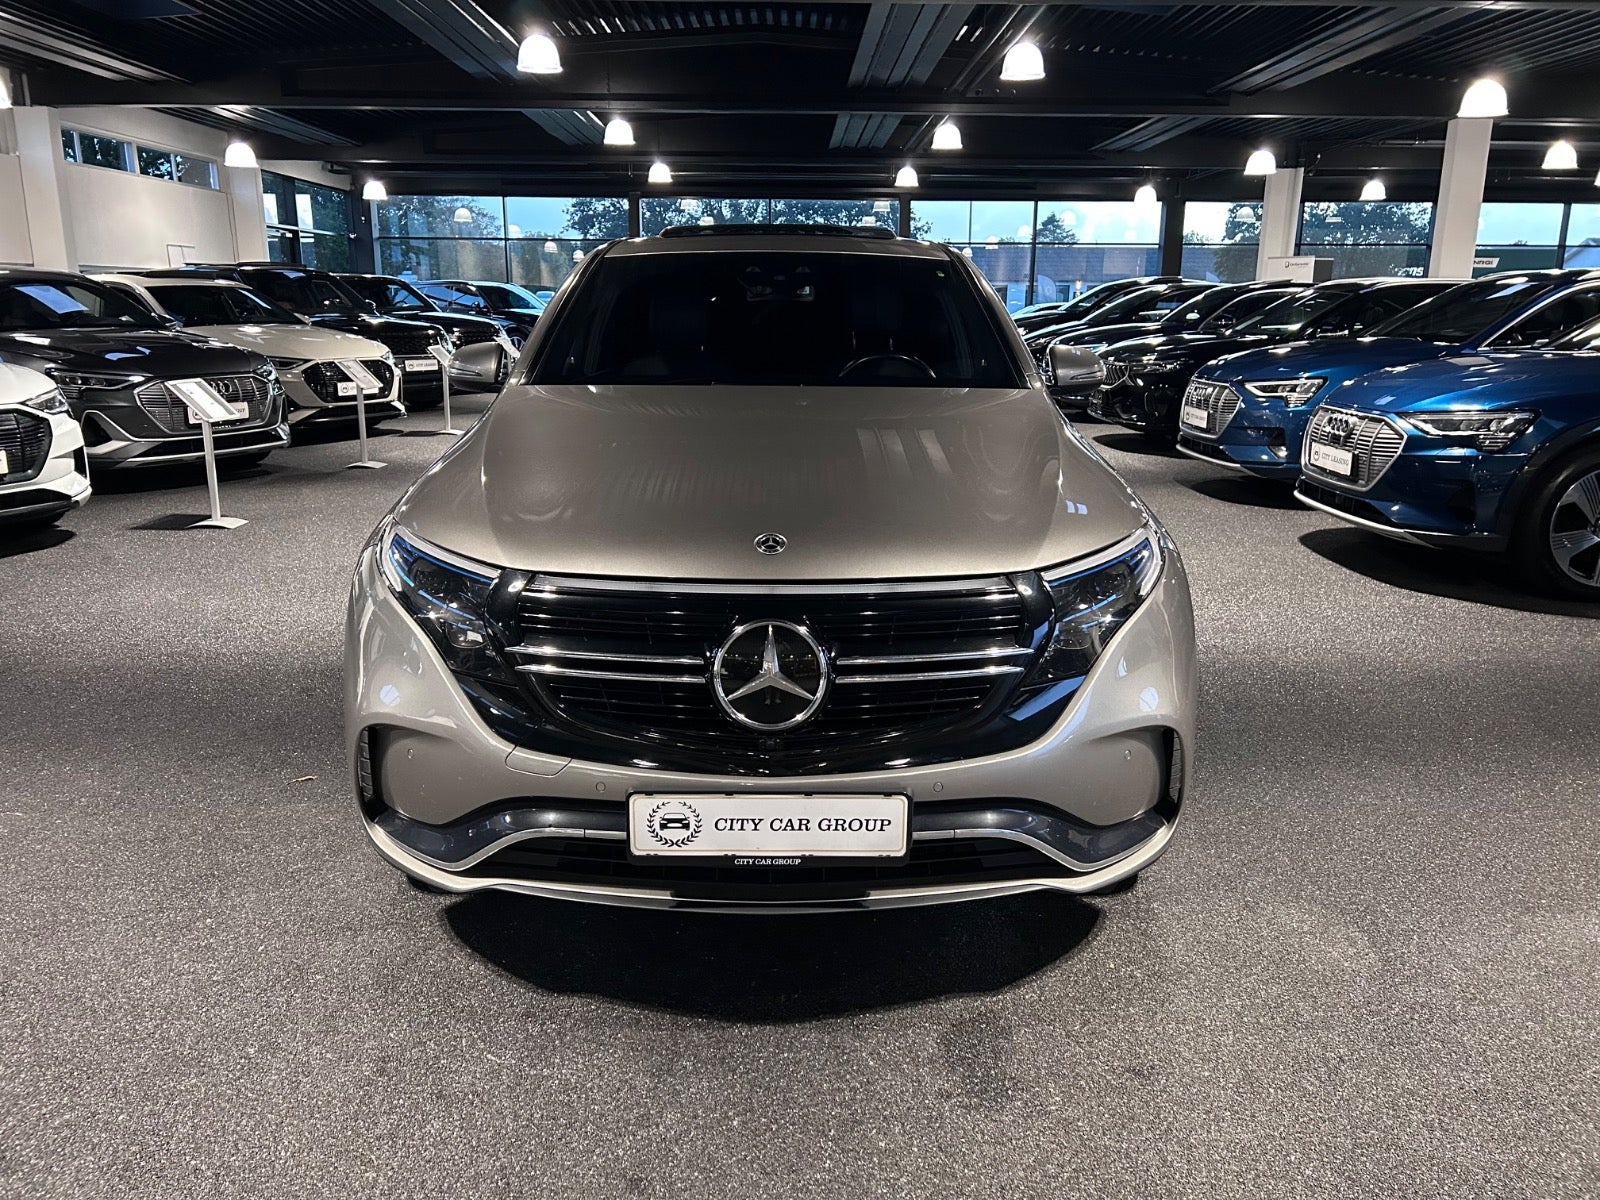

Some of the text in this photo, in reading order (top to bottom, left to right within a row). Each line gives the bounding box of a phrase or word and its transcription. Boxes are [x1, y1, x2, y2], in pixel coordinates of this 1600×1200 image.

[714, 817, 892, 832] CITY CAR GROUP
